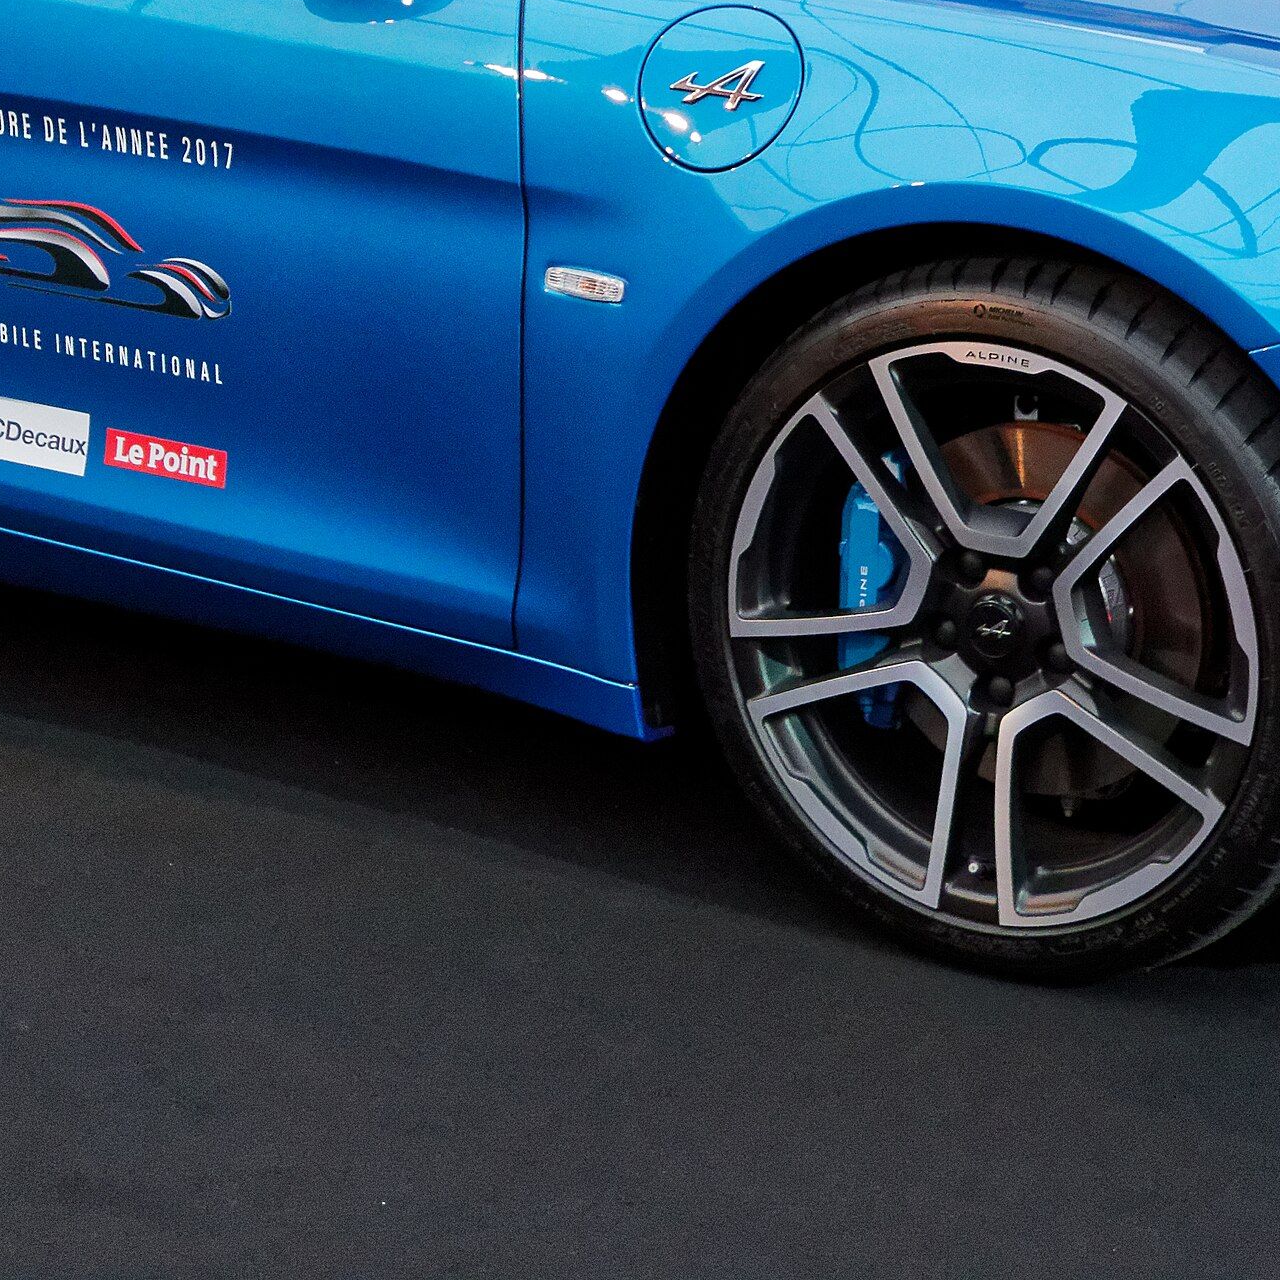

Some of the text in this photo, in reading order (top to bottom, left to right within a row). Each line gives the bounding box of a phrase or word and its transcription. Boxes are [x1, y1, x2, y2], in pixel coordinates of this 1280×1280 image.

[43, 116, 67, 144] DE
[79, 121, 168, 160] L'ANNEE
[182, 136, 233, 169] 2017
[55, 333, 223, 385] INTERNATIONAL
[966, 351, 1029, 368] ALPINE
[113, 435, 218, 481] Le Point
